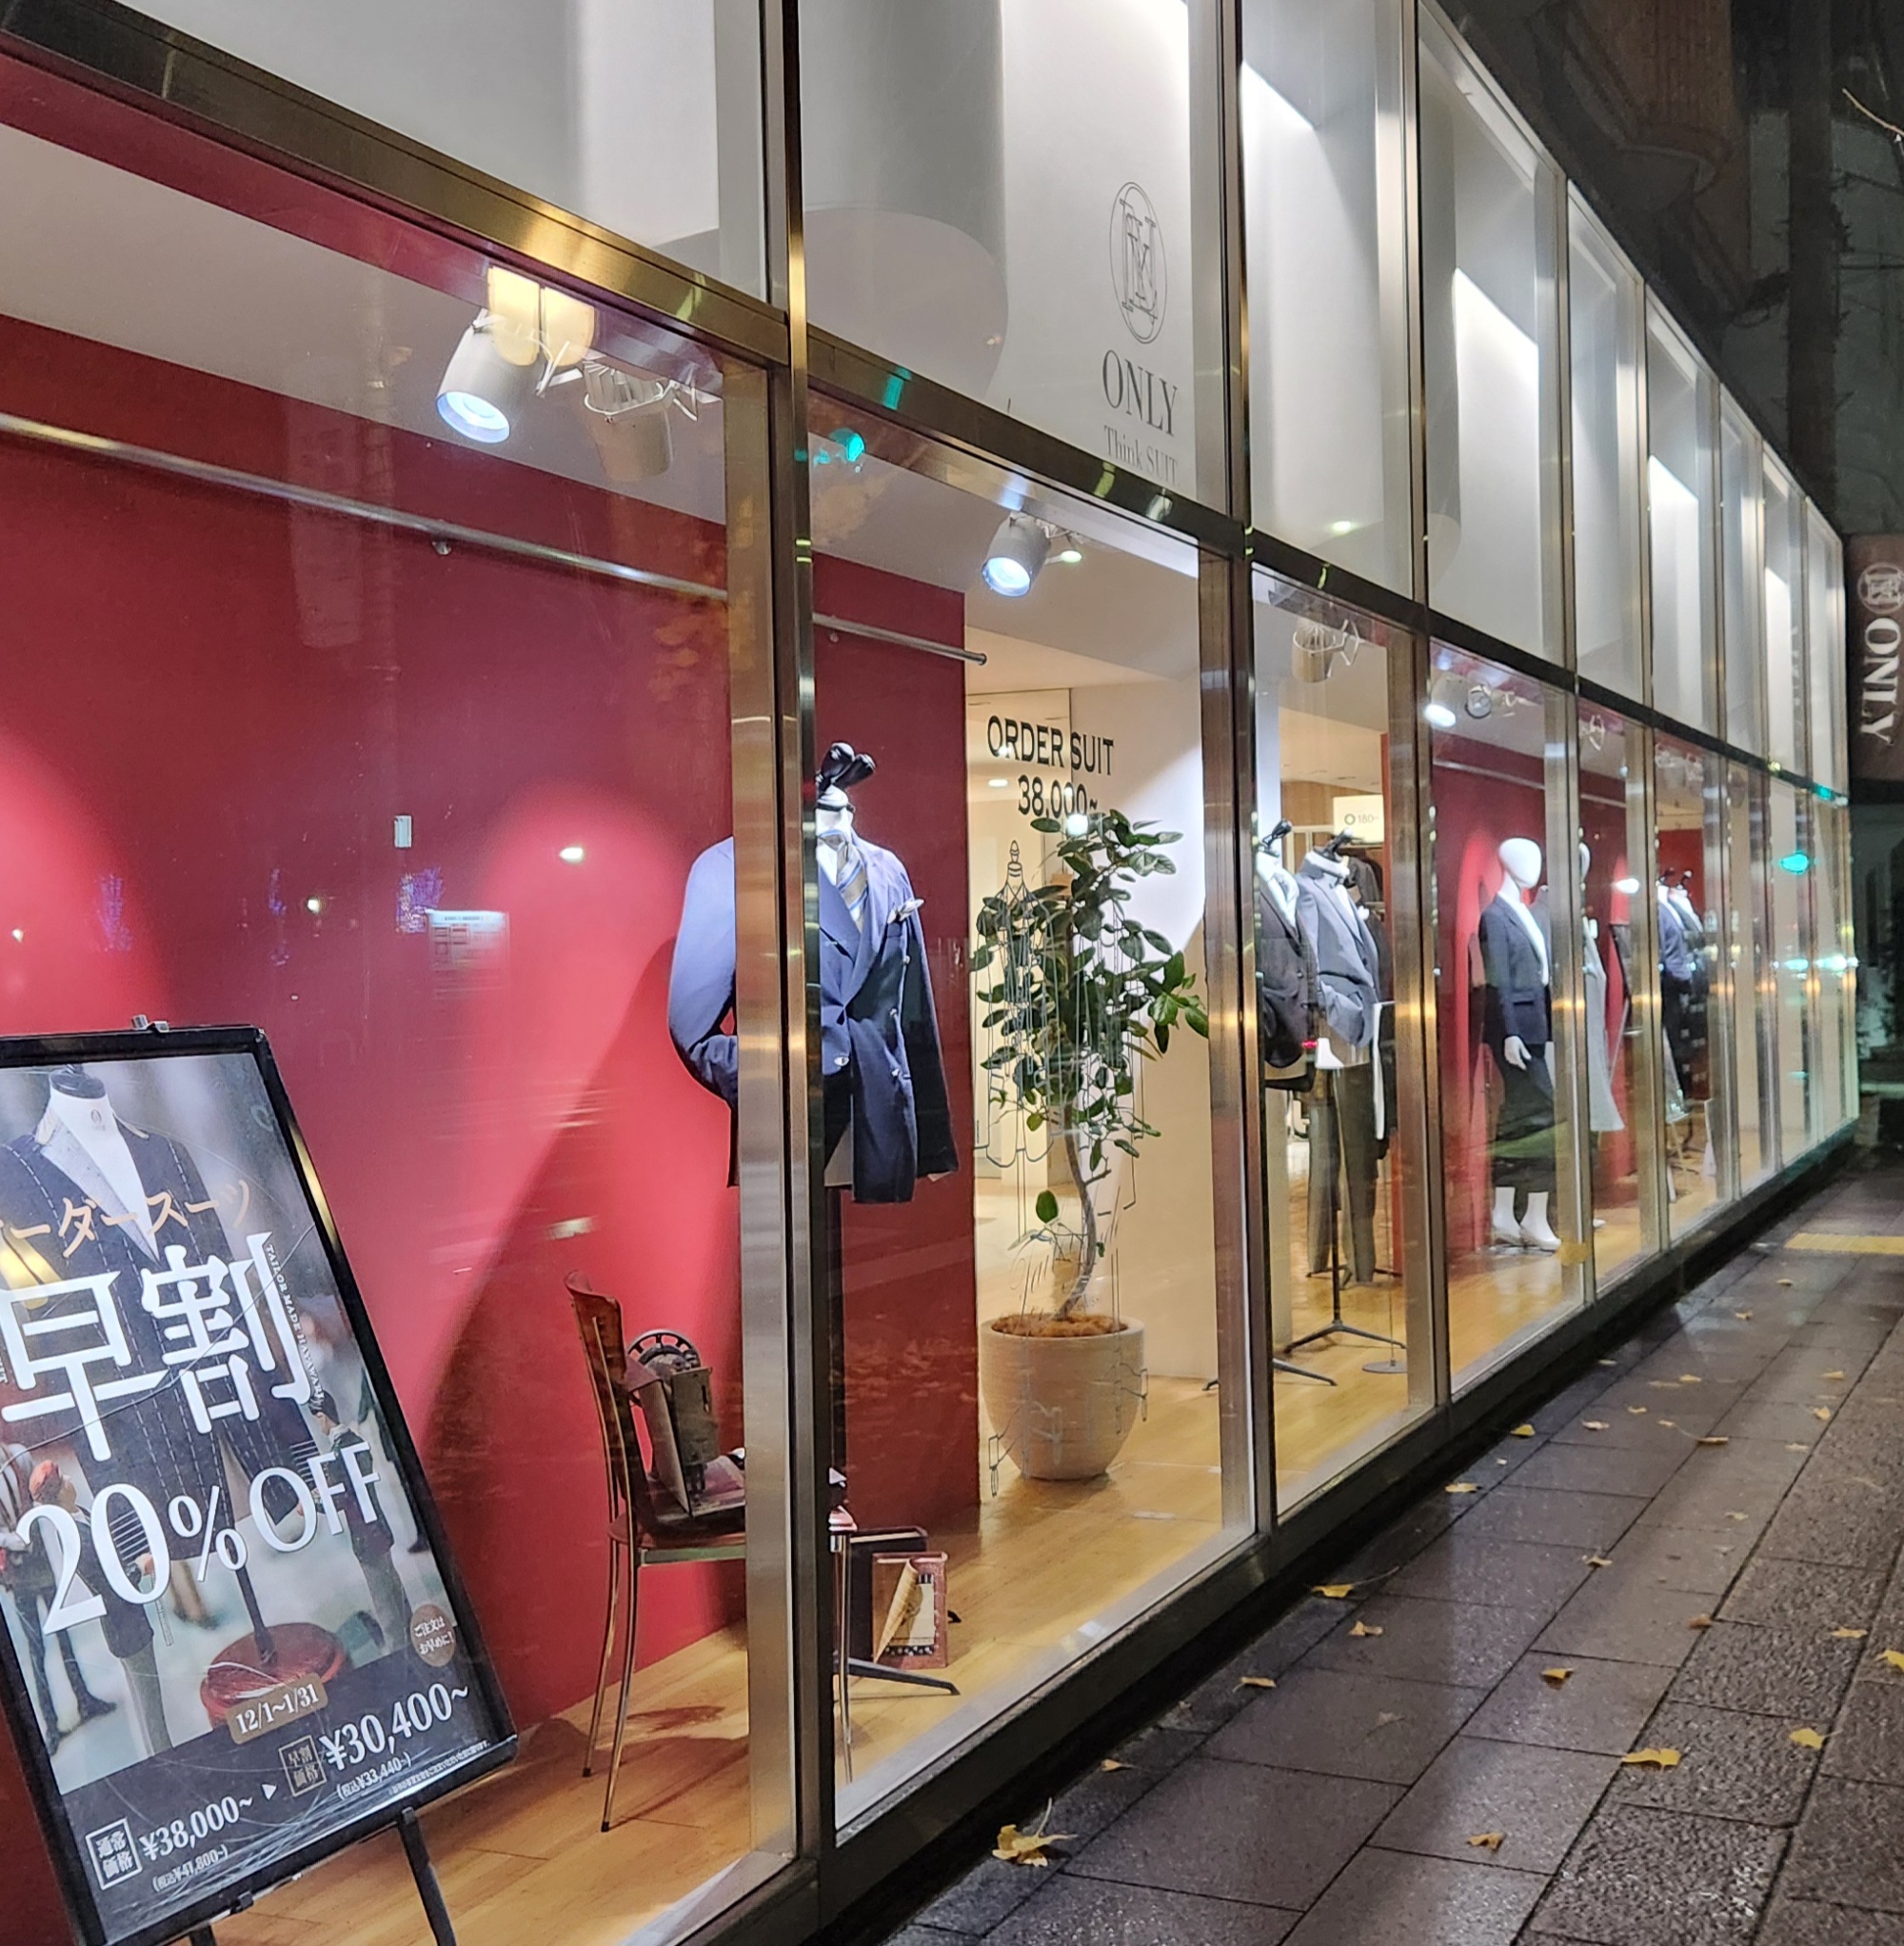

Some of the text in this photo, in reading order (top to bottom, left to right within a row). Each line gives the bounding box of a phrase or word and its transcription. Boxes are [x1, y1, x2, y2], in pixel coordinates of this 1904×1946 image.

[1102, 349, 1179, 437] ONLY
[1104, 425, 1142, 470] Think
[1860, 617, 1901, 746] ONLY
[987, 715, 1115, 776] ORDER SUIT
[0, 1180, 250, 1259] ーダースーツ
[266, 1243, 288, 1292] TAILOR
[284, 1294, 303, 1332] MADE
[0, 1231, 312, 1463] 早割
[16, 1441, 381, 1636] 20% OFF
